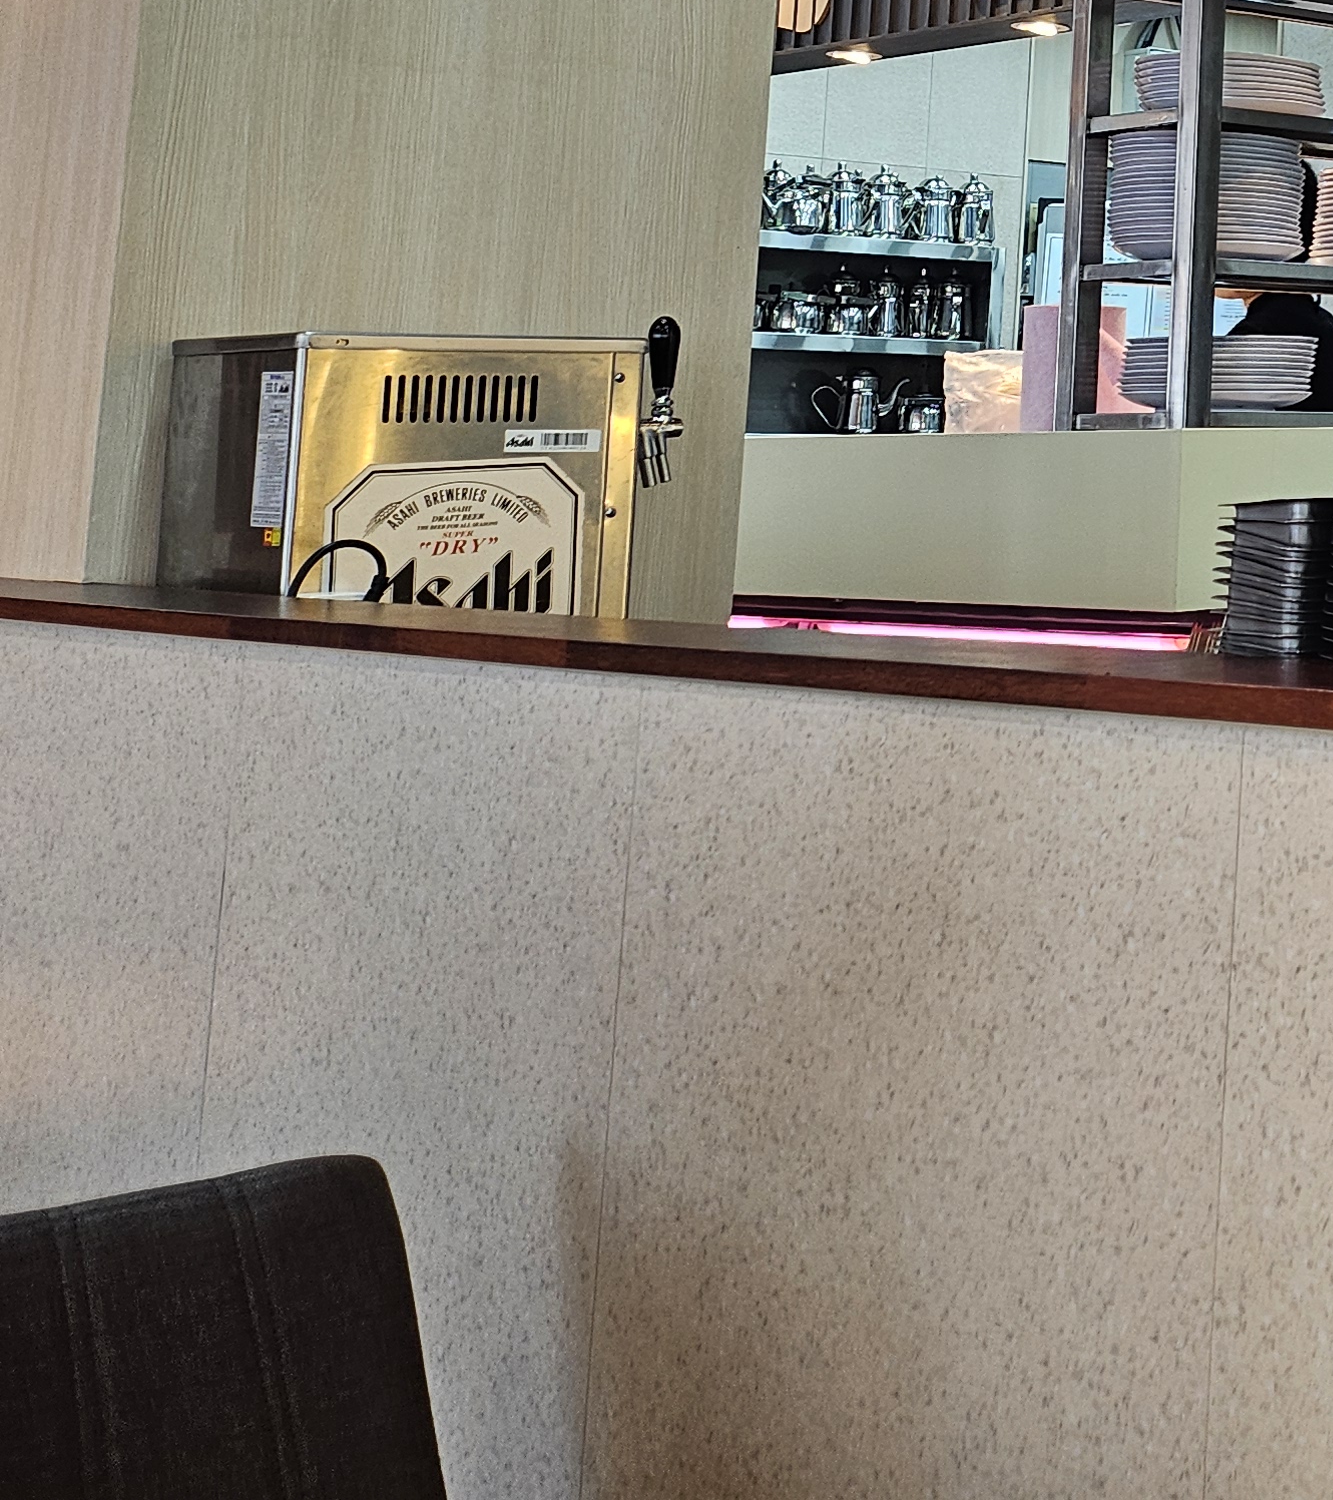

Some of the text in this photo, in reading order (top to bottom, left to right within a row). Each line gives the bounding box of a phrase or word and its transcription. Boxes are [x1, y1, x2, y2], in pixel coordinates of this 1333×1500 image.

[386, 487, 529, 531] ASAHI BREWERIES LIMITED
[445, 505, 473, 513] ASAHI
[431, 513, 485, 523] DRAFT BEER
[441, 530, 474, 539] SUPER
